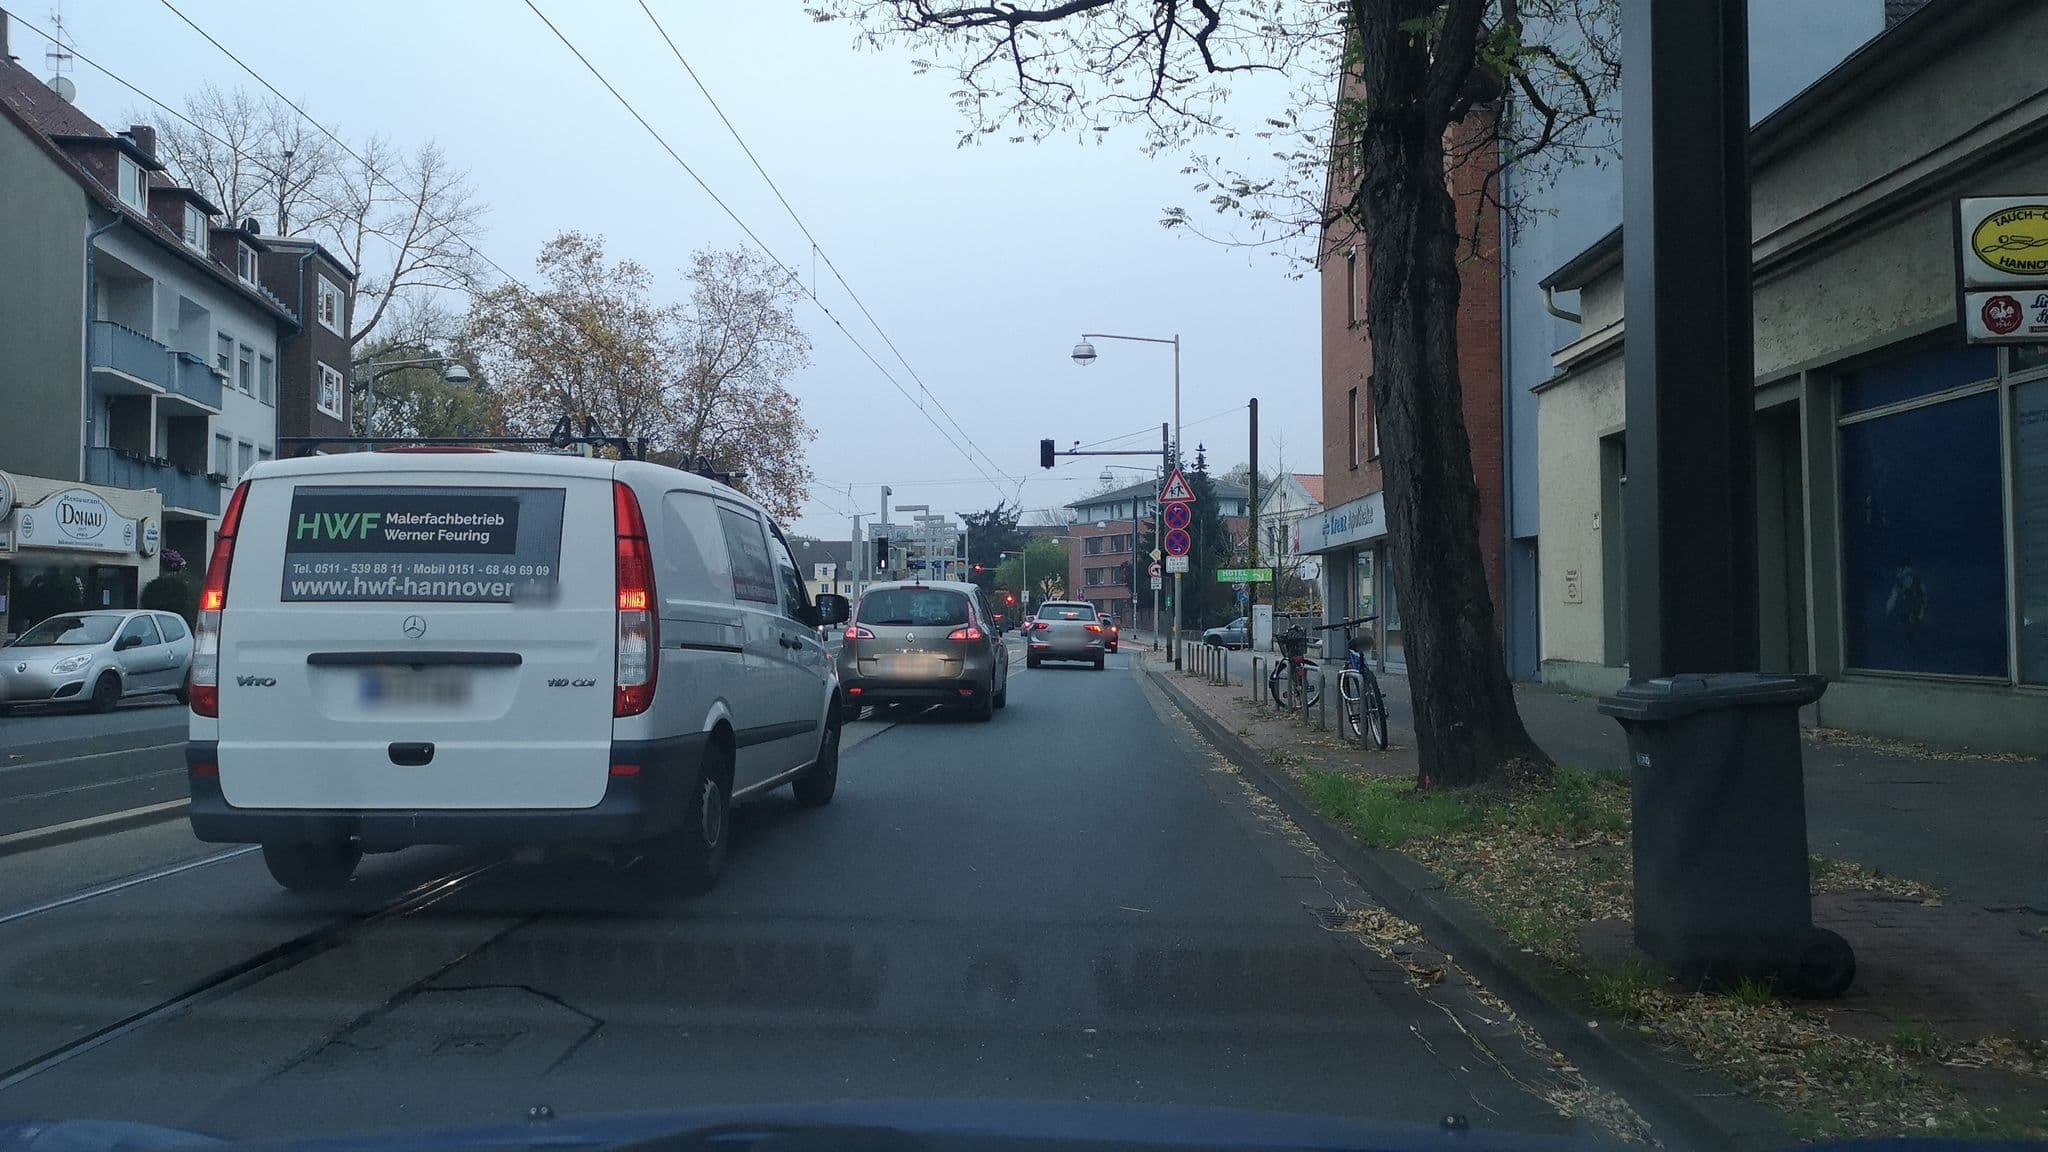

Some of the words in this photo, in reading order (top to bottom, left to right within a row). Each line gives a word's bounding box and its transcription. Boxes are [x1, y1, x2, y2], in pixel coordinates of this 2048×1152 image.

[2000, 256, 2048, 270] HANNO
[296, 512, 381, 539] HWF
[386, 513, 505, 526] Malerfachbetrieb
[385, 528, 434, 541] Werner
[438, 529, 490, 544] Feuring
[293, 564, 312, 574] Tel.
[315, 564, 340, 574] 0511
[351, 564, 372, 574] 539
[374, 564, 387, 574] 88
[391, 564, 403, 574] 11
[413, 564, 446, 574] Mobil
[448, 564, 474, 575] 0151
[485, 565, 499, 575] 68
[502, 565, 516, 576] 49
[519, 566, 533, 576] 69
[535, 566, 550, 577] 09
[1222, 569, 1248, 577] HOTEL
[291, 577, 547, 598] www.hwf-hannover
